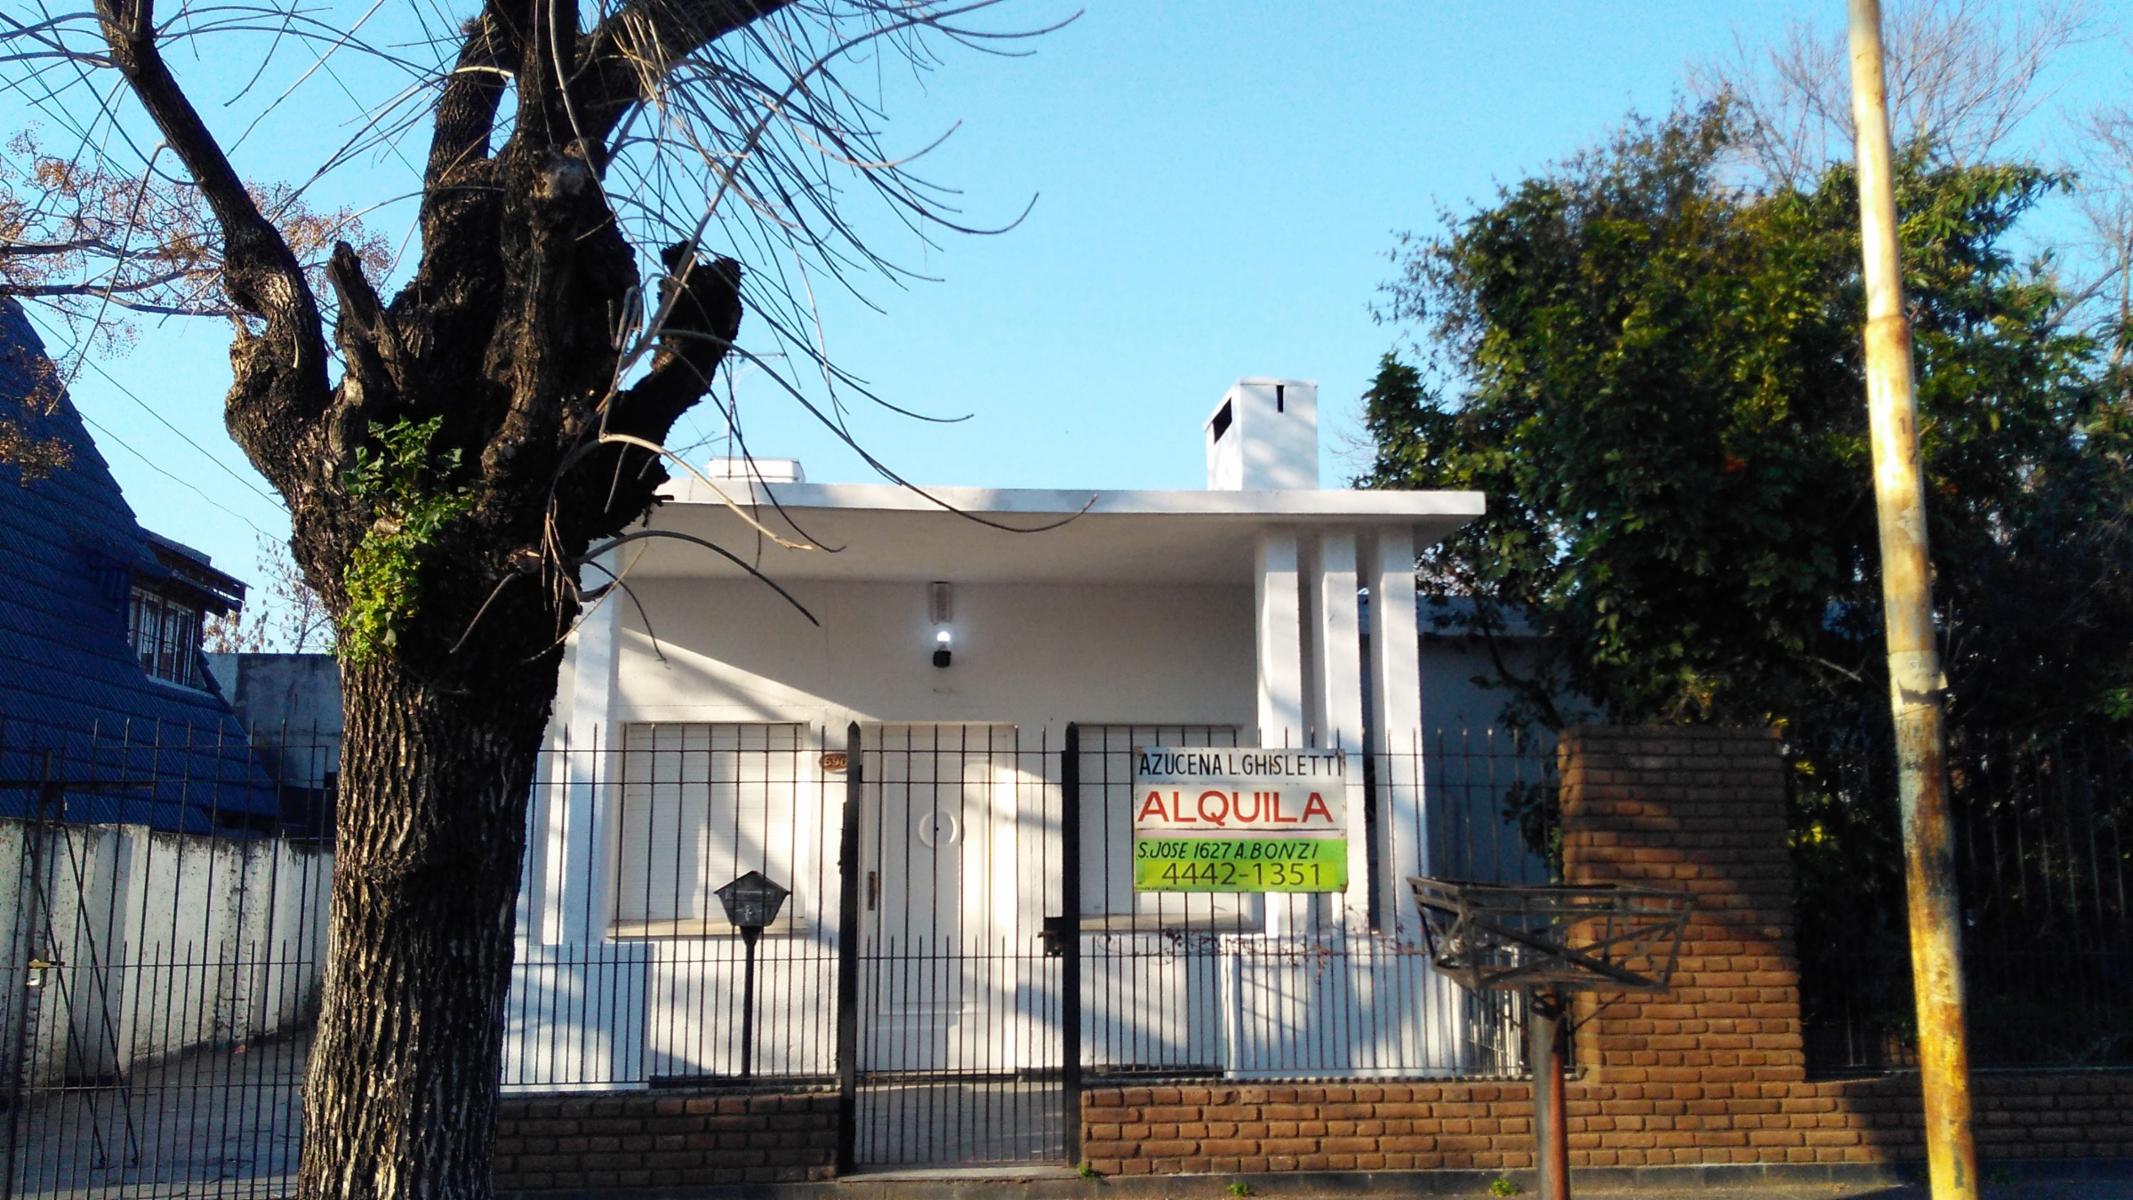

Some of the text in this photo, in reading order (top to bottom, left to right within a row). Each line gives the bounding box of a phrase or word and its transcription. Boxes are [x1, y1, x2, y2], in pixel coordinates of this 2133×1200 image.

[1138, 753, 1222, 776] AZUCENA
[1138, 790, 1333, 826] ALQUILA
[1193, 841, 1229, 860] 1627
[1161, 862, 1319, 886] 4442-1351
